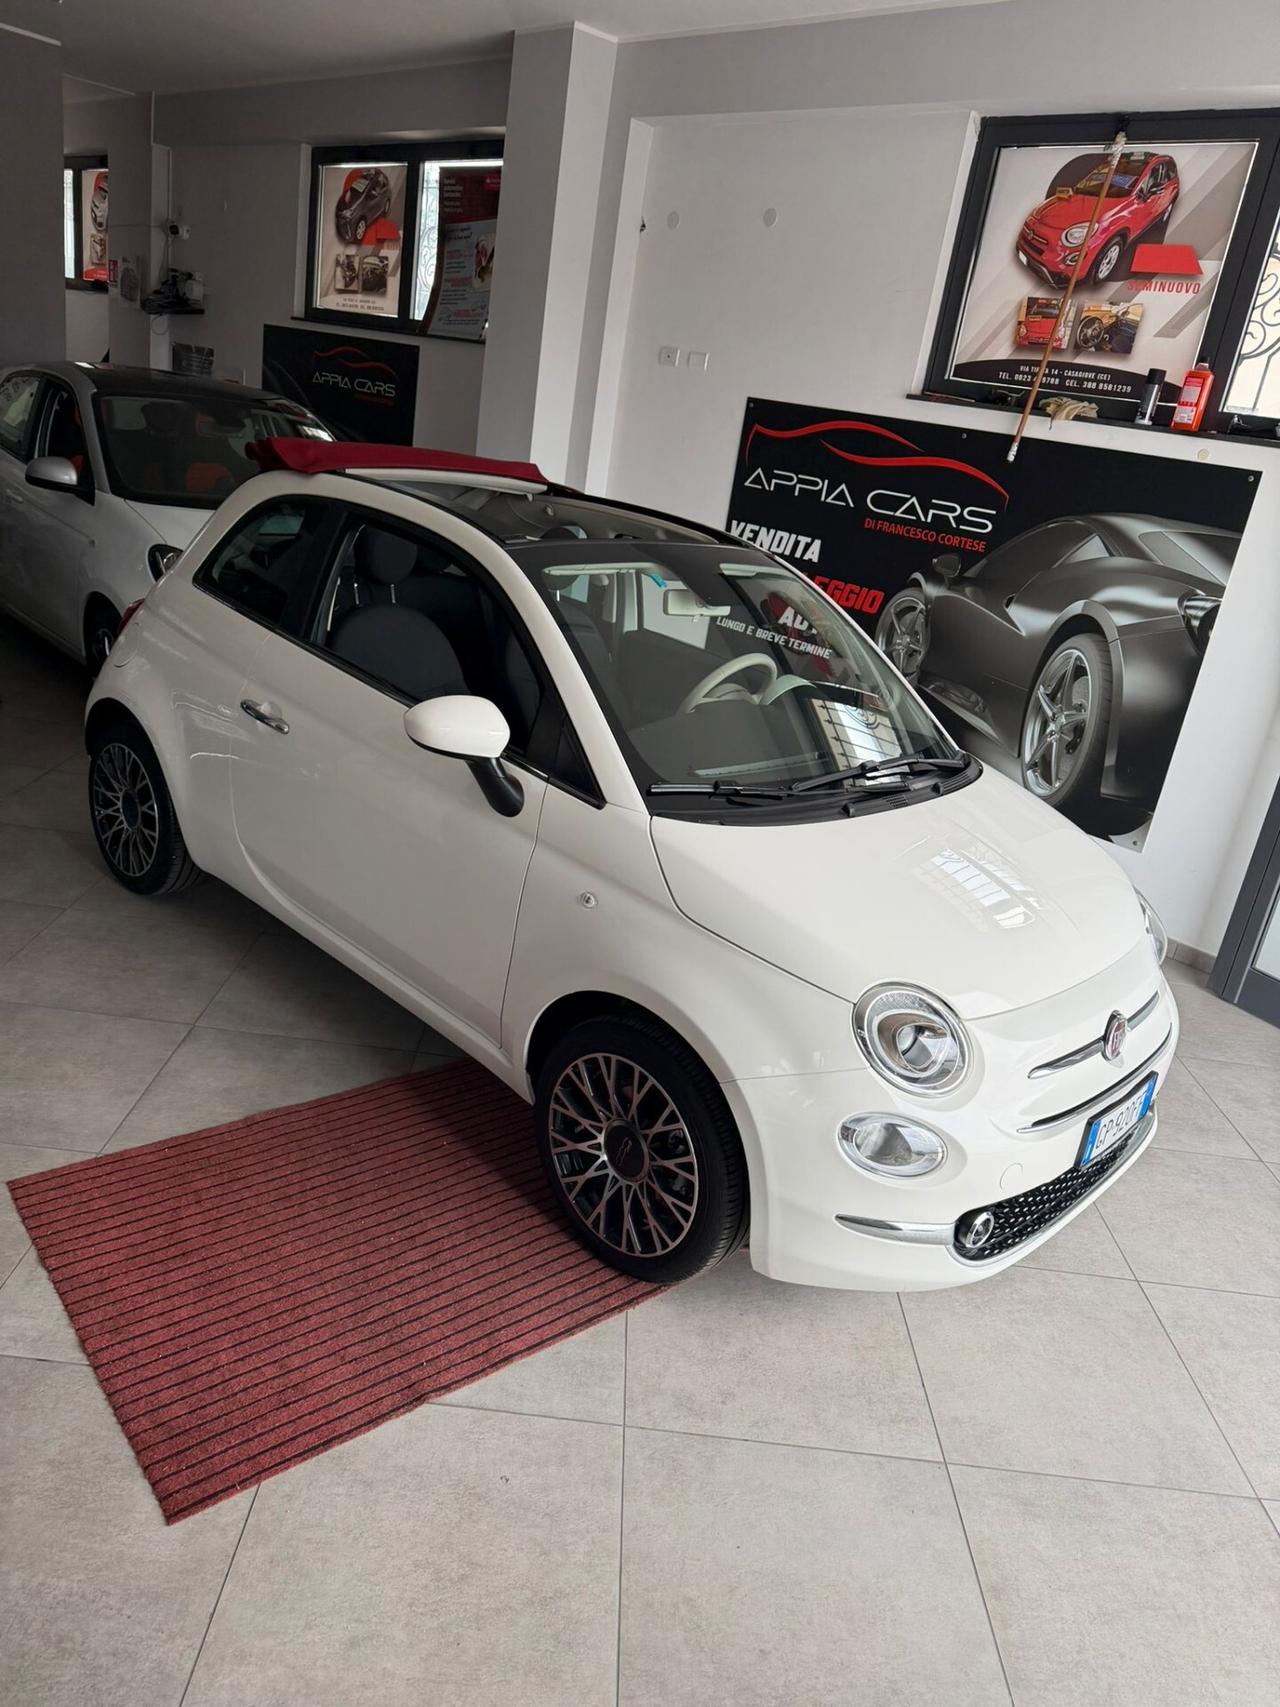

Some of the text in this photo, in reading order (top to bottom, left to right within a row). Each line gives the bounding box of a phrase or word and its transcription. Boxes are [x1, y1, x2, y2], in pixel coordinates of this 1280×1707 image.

[312, 371, 396, 397] APPIA CARS
[1063, 370, 1095, 380] CASAGIOVE
[744, 467, 997, 534] APPIA CARS
[730, 519, 822, 563] VENDITA
[864, 518, 987, 552] DI FRANCESCO CORTESE
[716, 617, 833, 659] LUNGO E BREVE TERMINE
